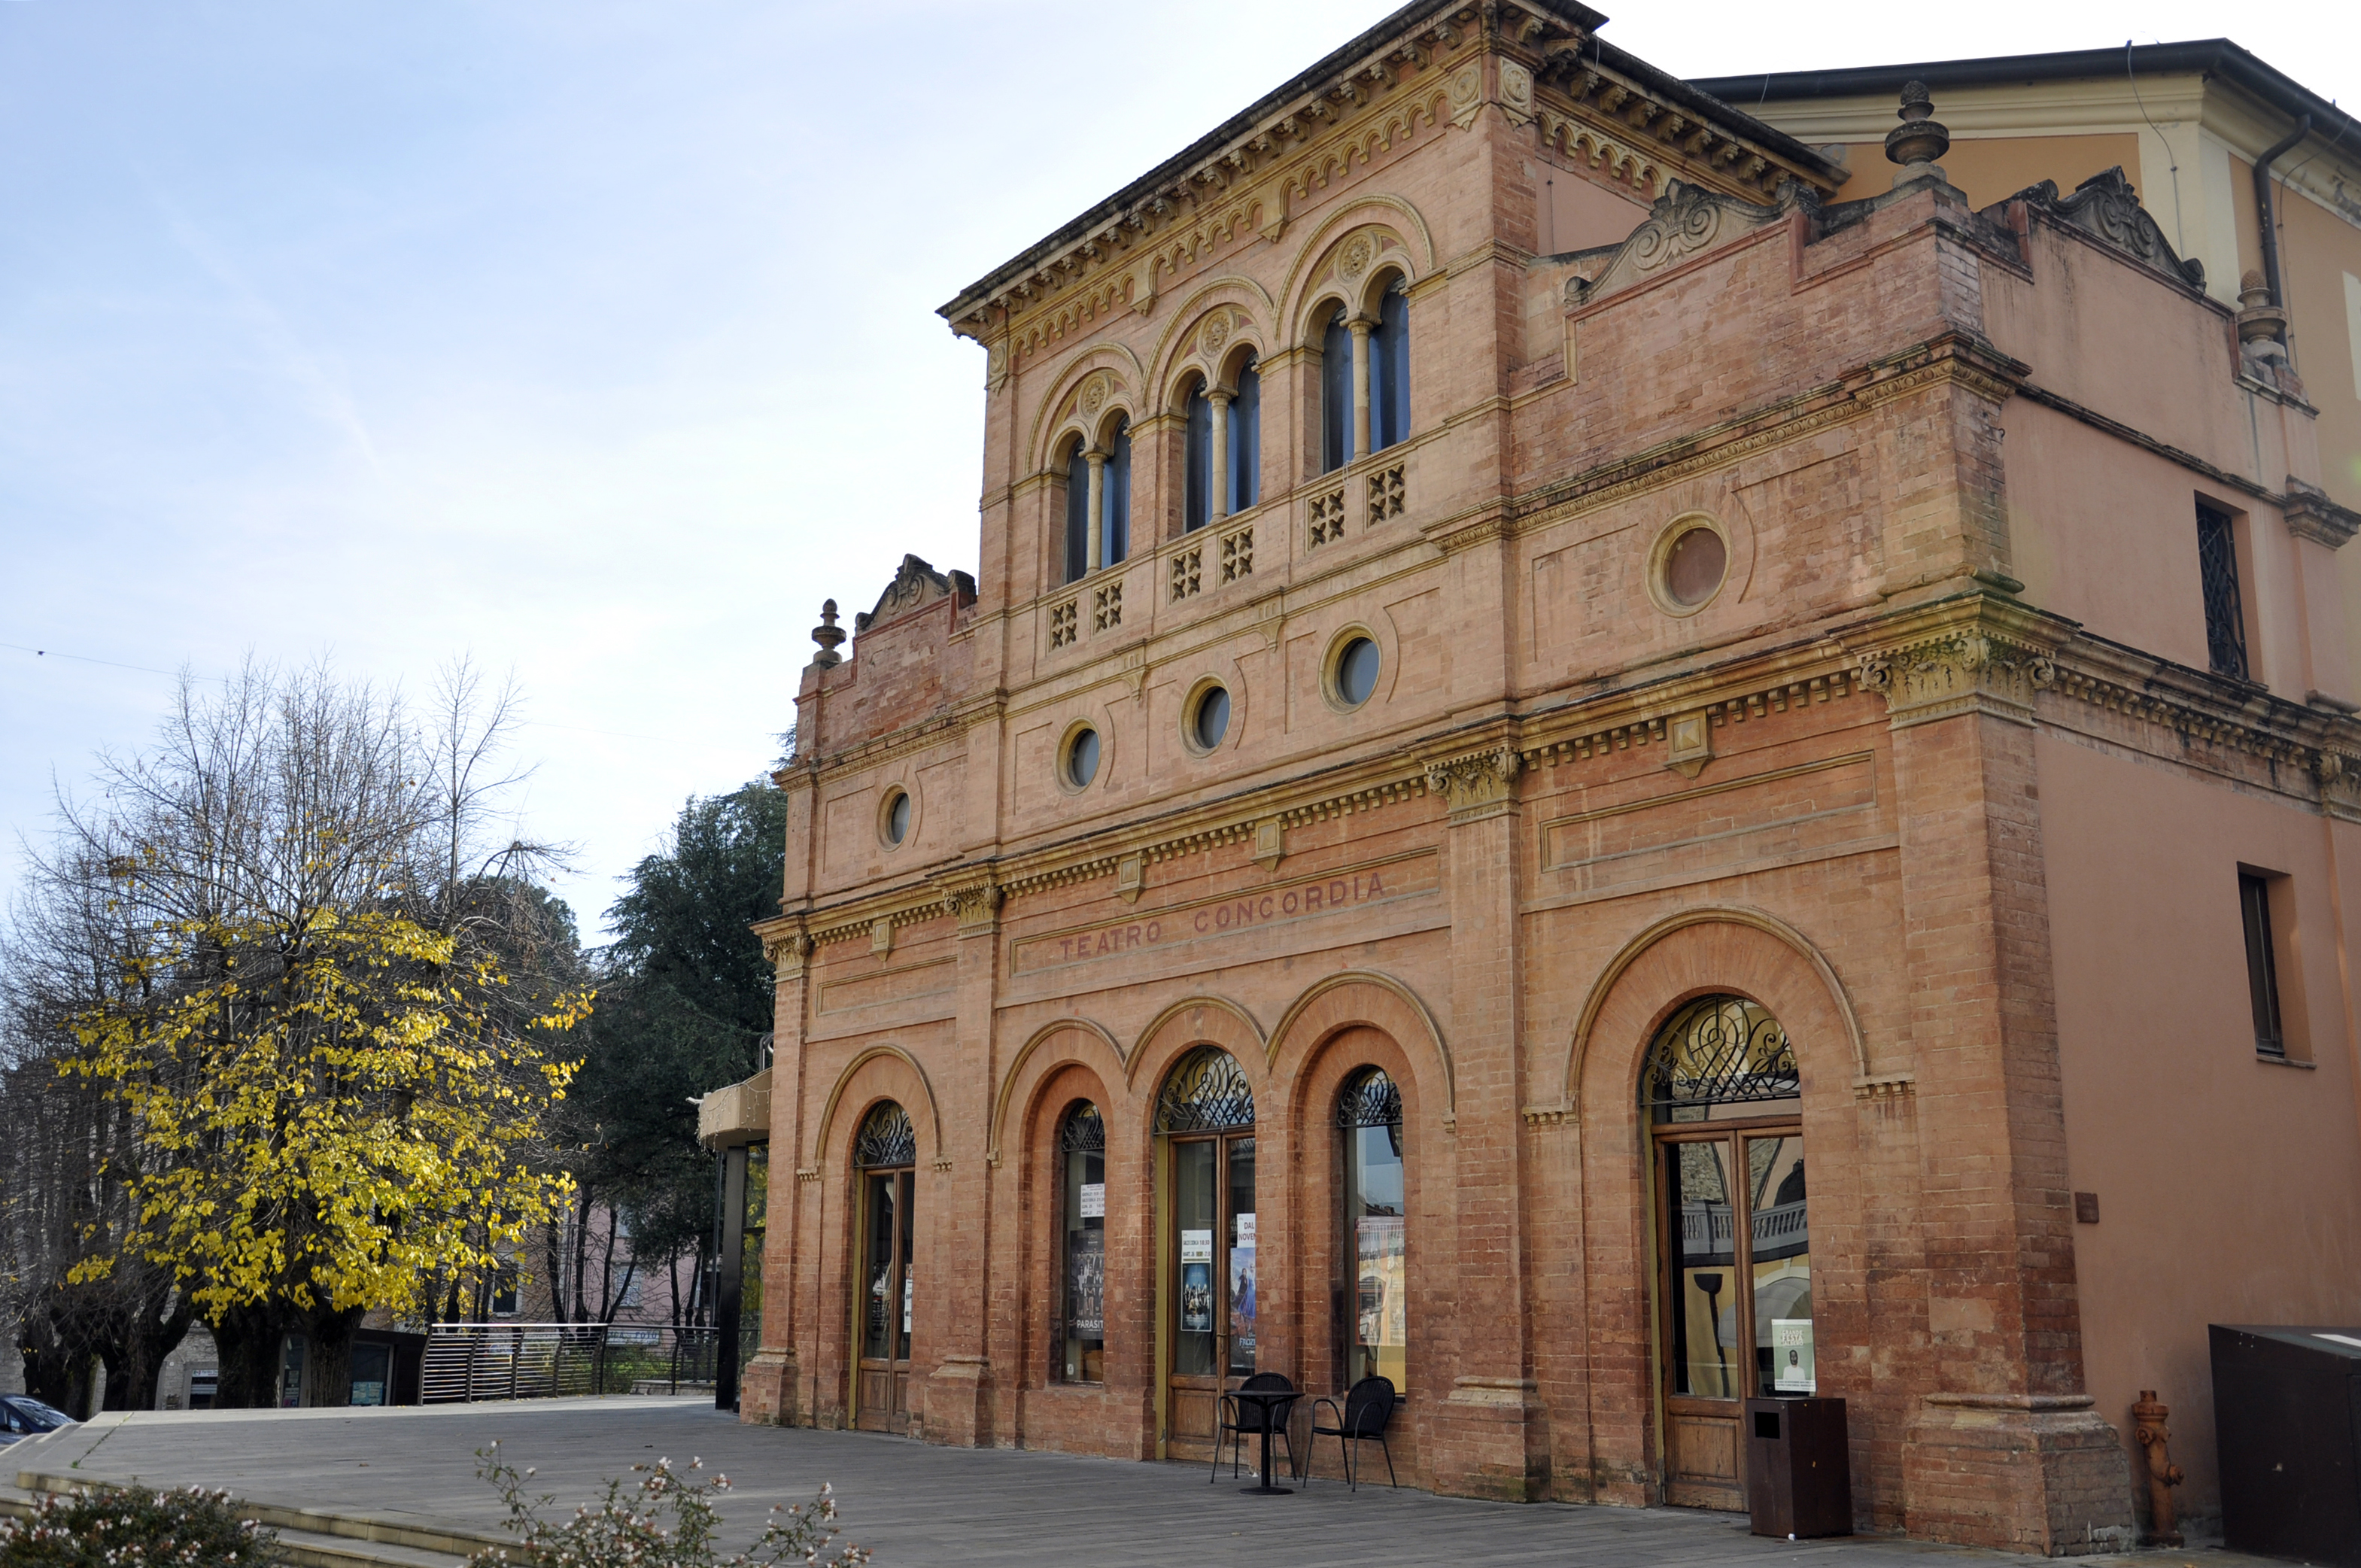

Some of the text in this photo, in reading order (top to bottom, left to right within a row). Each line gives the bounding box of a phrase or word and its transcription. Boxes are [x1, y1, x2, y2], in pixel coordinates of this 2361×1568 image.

[1060, 872, 1385, 960] TEATRO CONCORDIA
[1244, 1221, 1255, 1230] DAL
[1077, 1319, 1104, 1329] PARASIT
